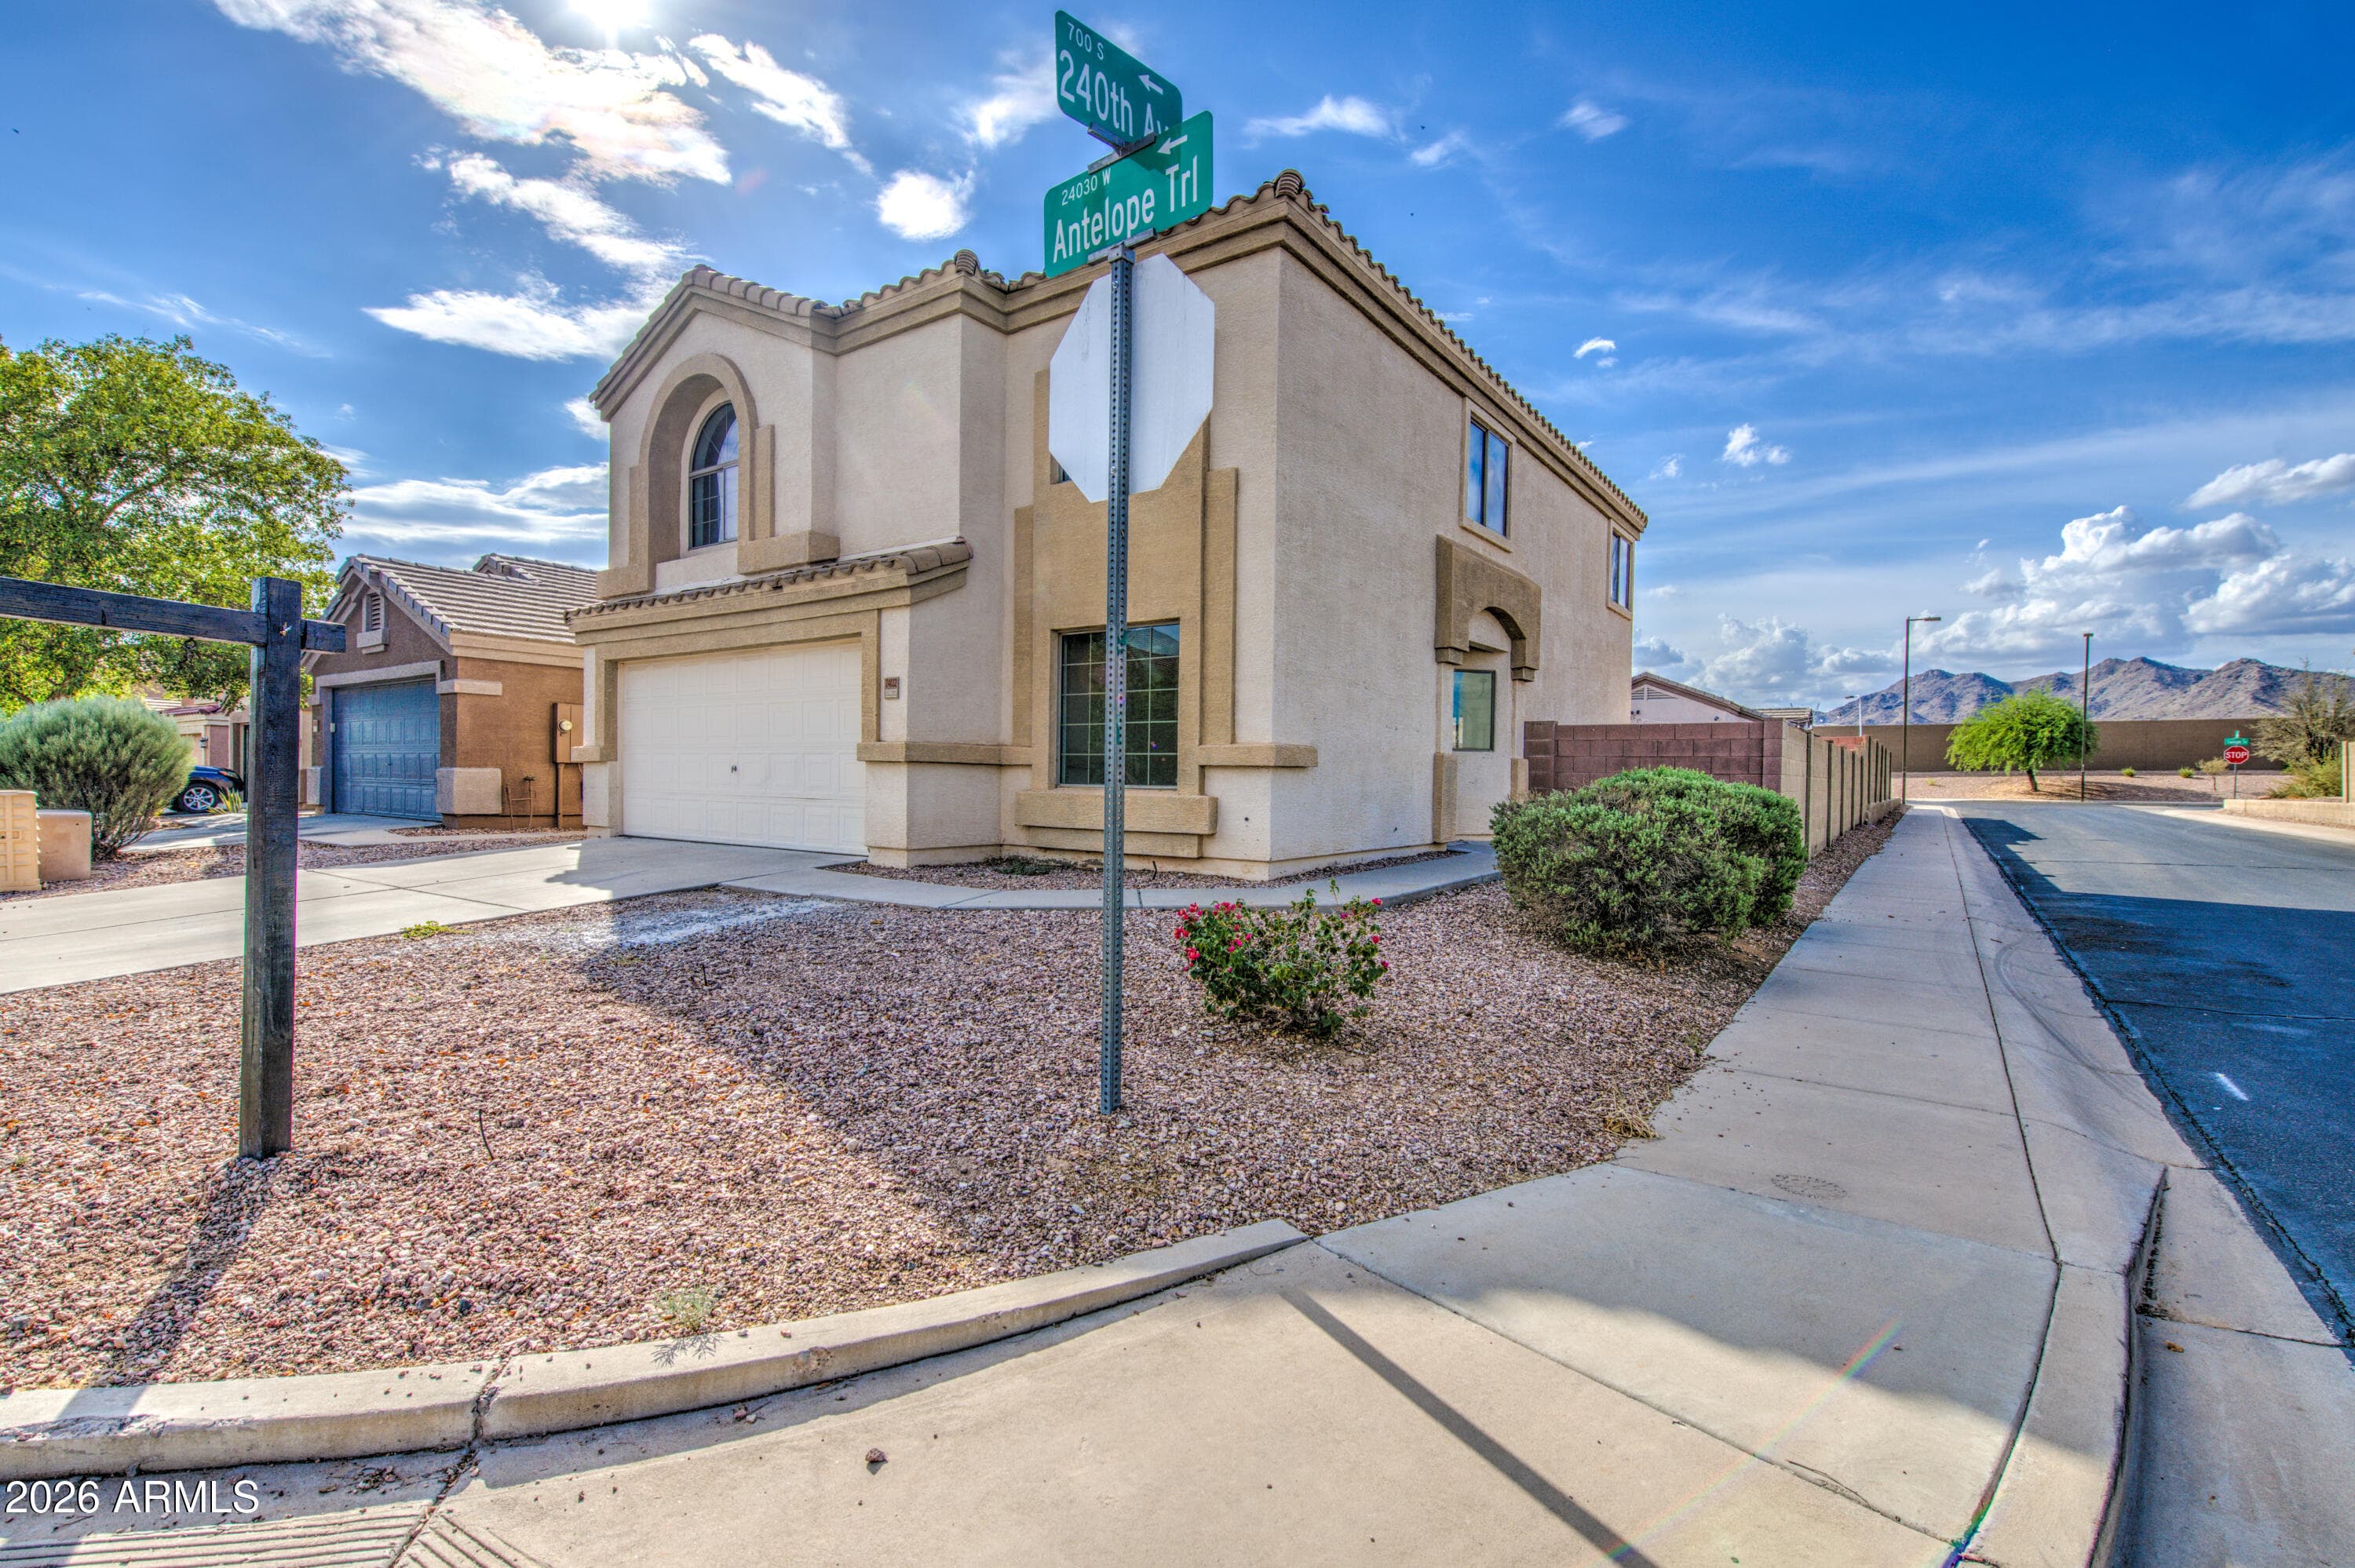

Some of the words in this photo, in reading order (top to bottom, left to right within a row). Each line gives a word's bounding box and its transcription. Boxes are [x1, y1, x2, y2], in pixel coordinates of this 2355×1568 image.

[1067, 21, 1092, 53] 700
[1097, 42, 1104, 60] S
[1059, 49, 1134, 137] 240th
[1053, 188, 1156, 264] Antelope
[1166, 155, 1198, 213] Trl
[1061, 175, 1097, 206] 24030
[1102, 168, 1112, 185] W
